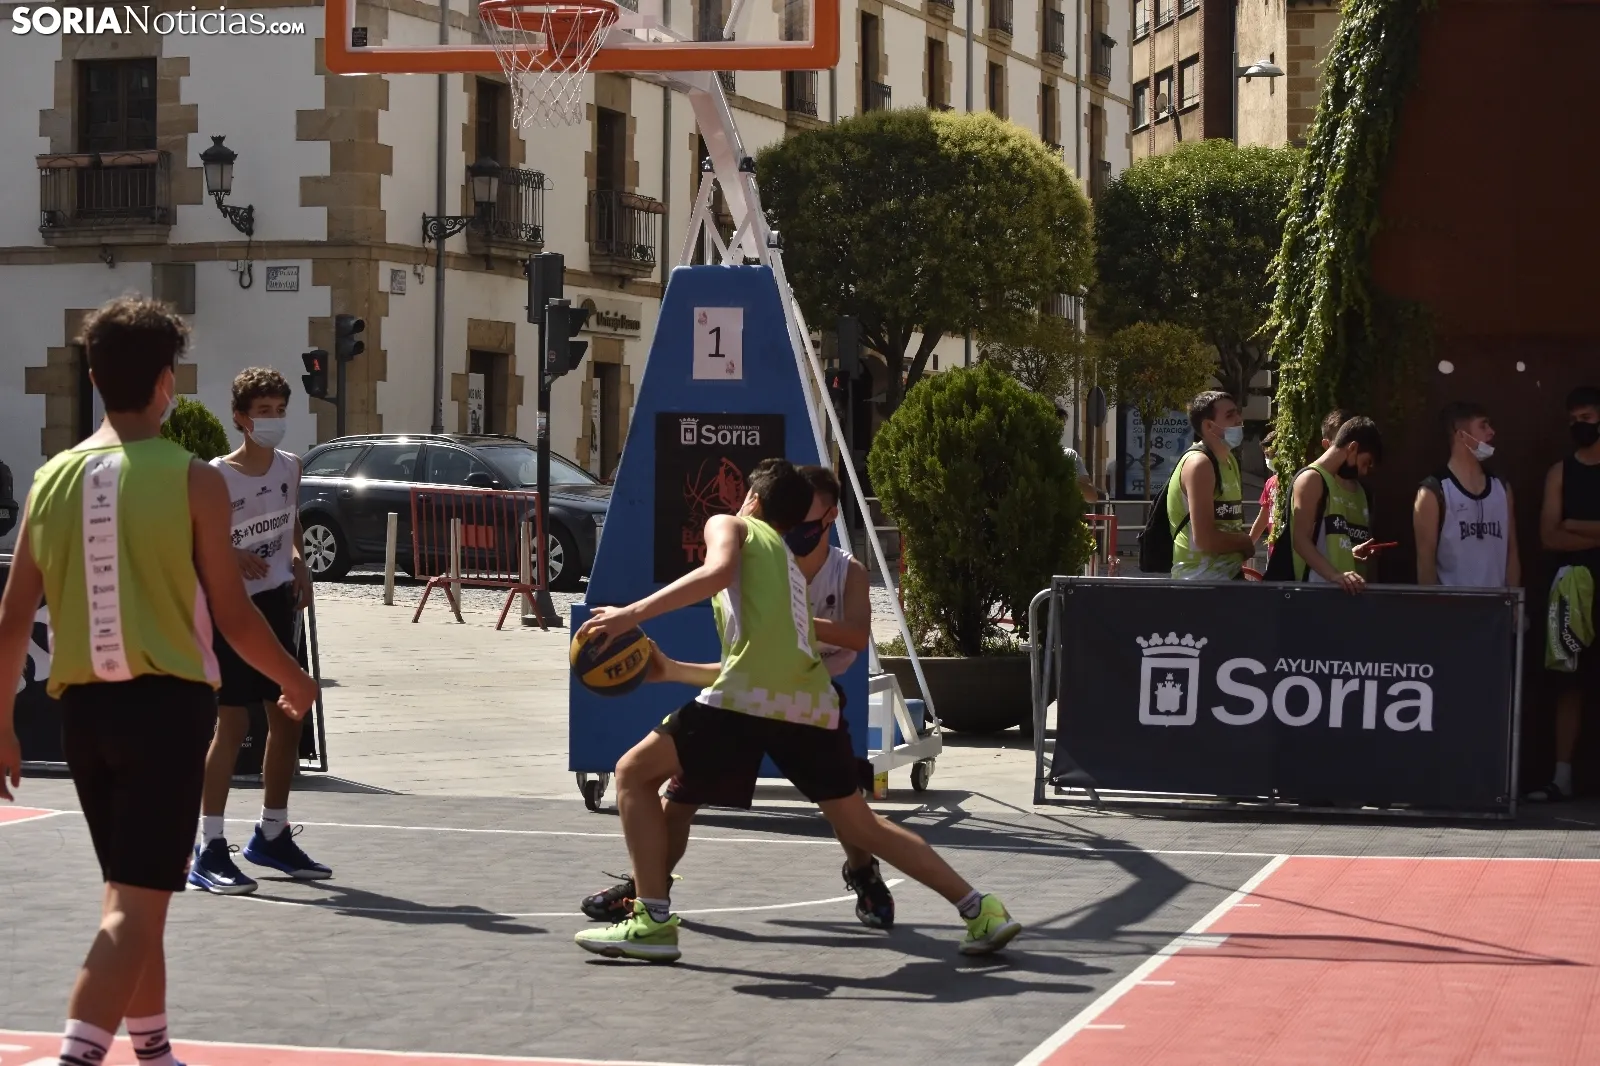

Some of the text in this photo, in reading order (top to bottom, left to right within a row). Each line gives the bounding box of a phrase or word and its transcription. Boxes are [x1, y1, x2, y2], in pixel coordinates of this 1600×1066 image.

[708, 326, 726, 358] 1
[700, 424, 761, 446] Soria
[1274, 657, 1434, 678] AYUNTAMIENTO
[1210, 657, 1434, 731] Soria
